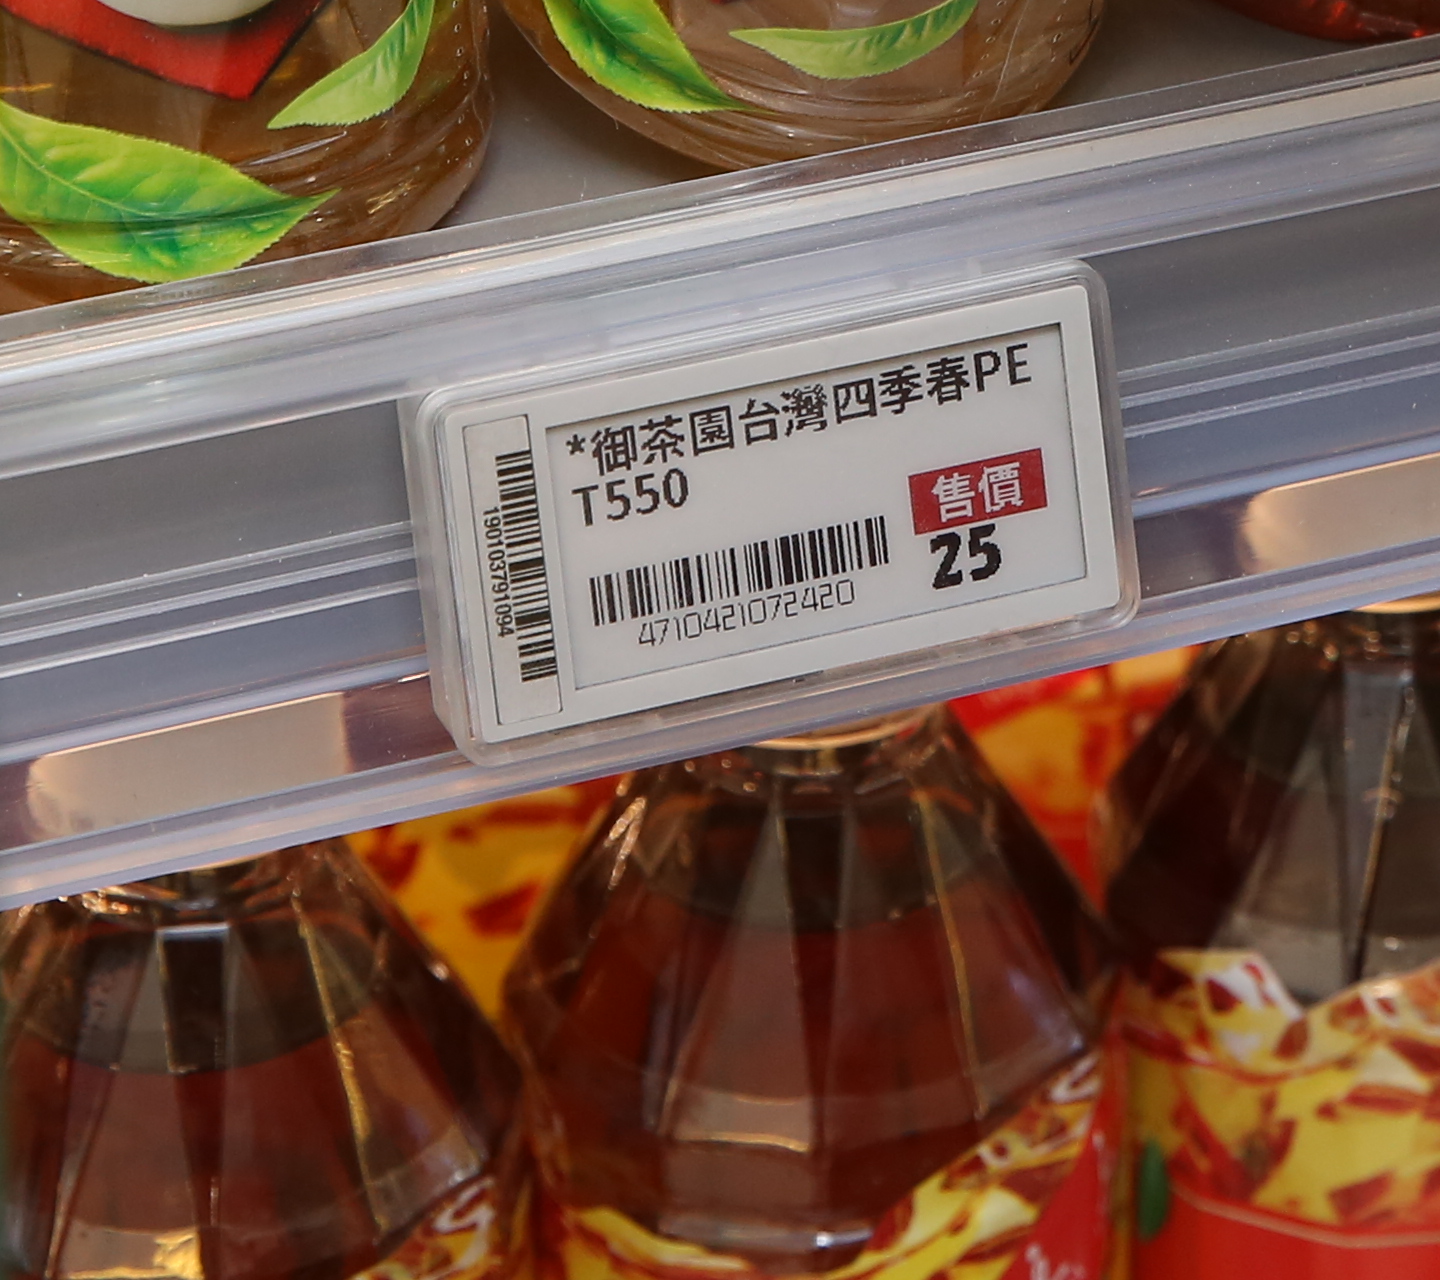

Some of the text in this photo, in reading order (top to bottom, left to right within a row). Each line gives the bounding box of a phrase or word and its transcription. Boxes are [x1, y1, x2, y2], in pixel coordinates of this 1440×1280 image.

[571, 467, 691, 529] T550
[931, 459, 1024, 523] 售價
[484, 505, 512, 640] 190103791094
[929, 523, 1004, 591] 25
[636, 577, 857, 650] 4710421072420
